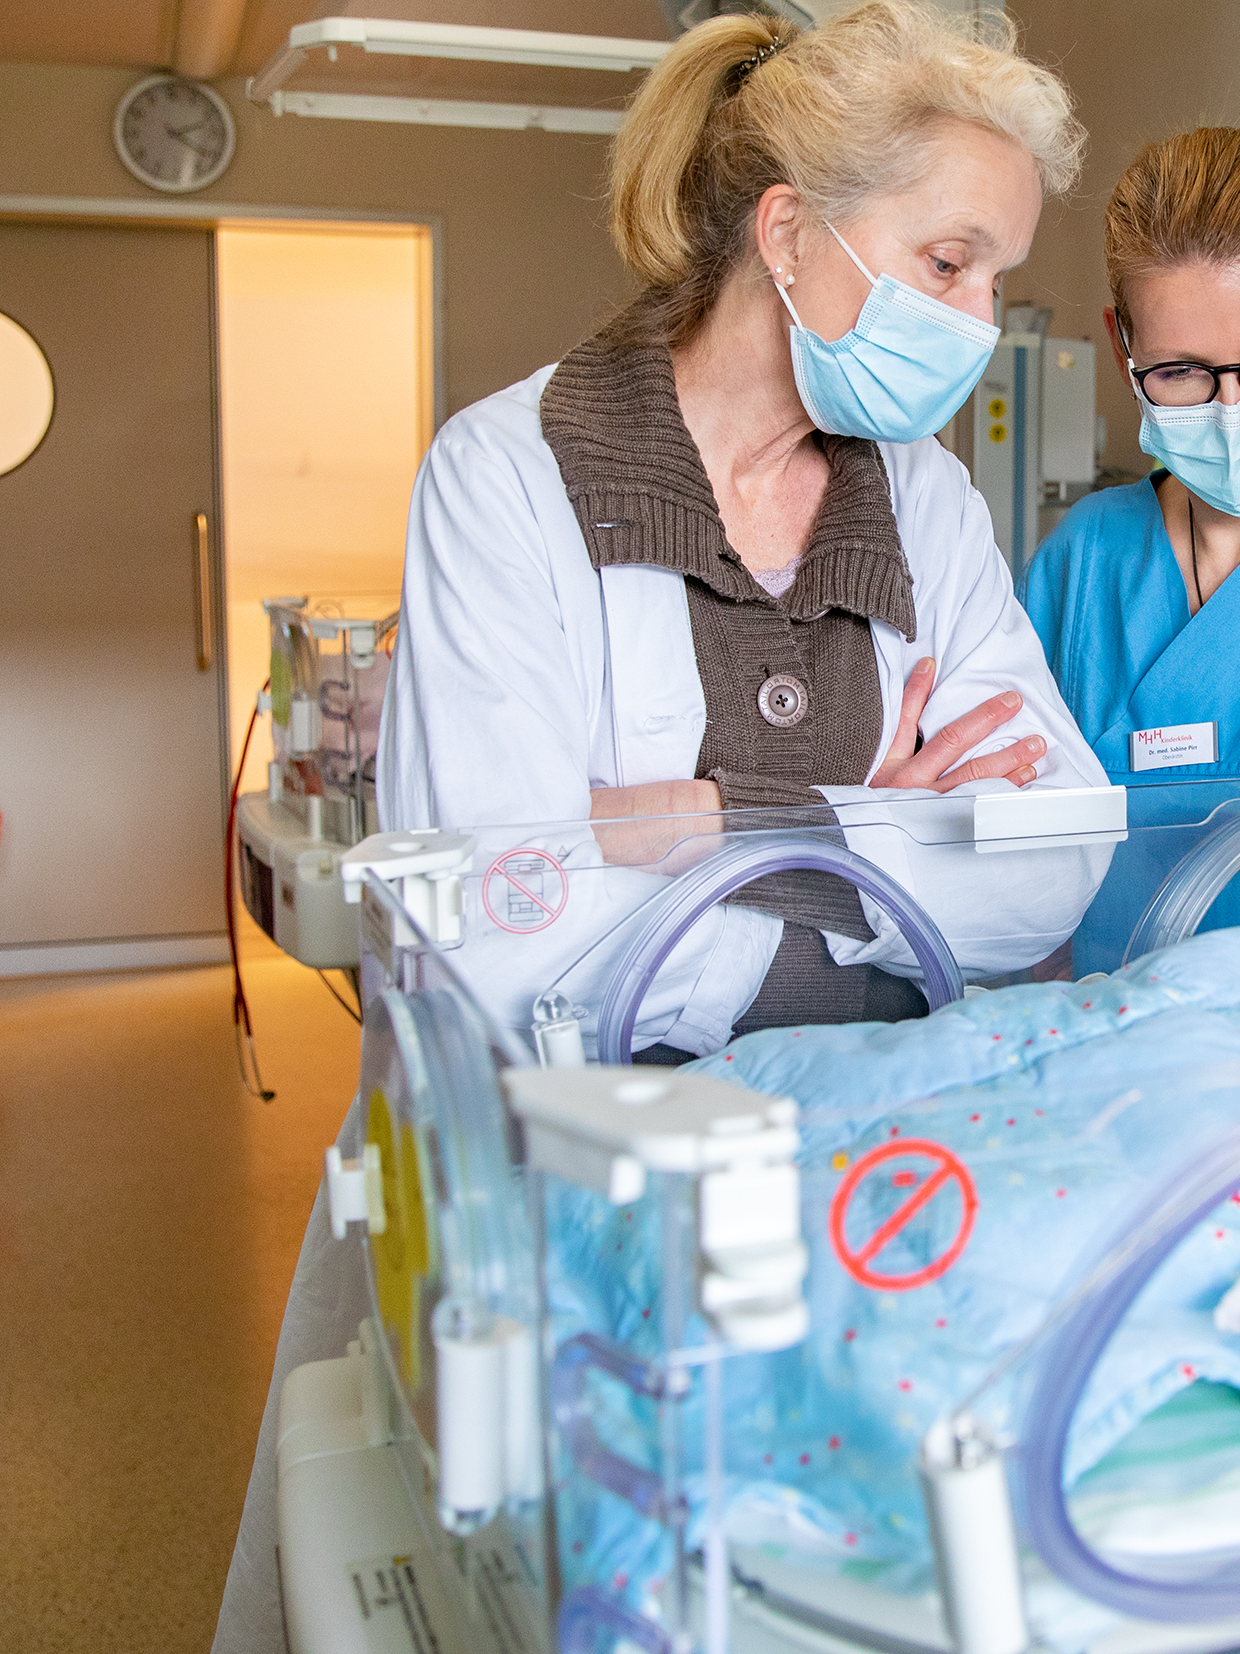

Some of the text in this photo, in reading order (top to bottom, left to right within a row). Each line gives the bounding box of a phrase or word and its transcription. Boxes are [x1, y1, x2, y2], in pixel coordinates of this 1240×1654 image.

[1138, 729, 1162, 745] MHH
[1161, 734, 1193, 744] Kinderklinik
[1170, 745, 1187, 753] Sabine
